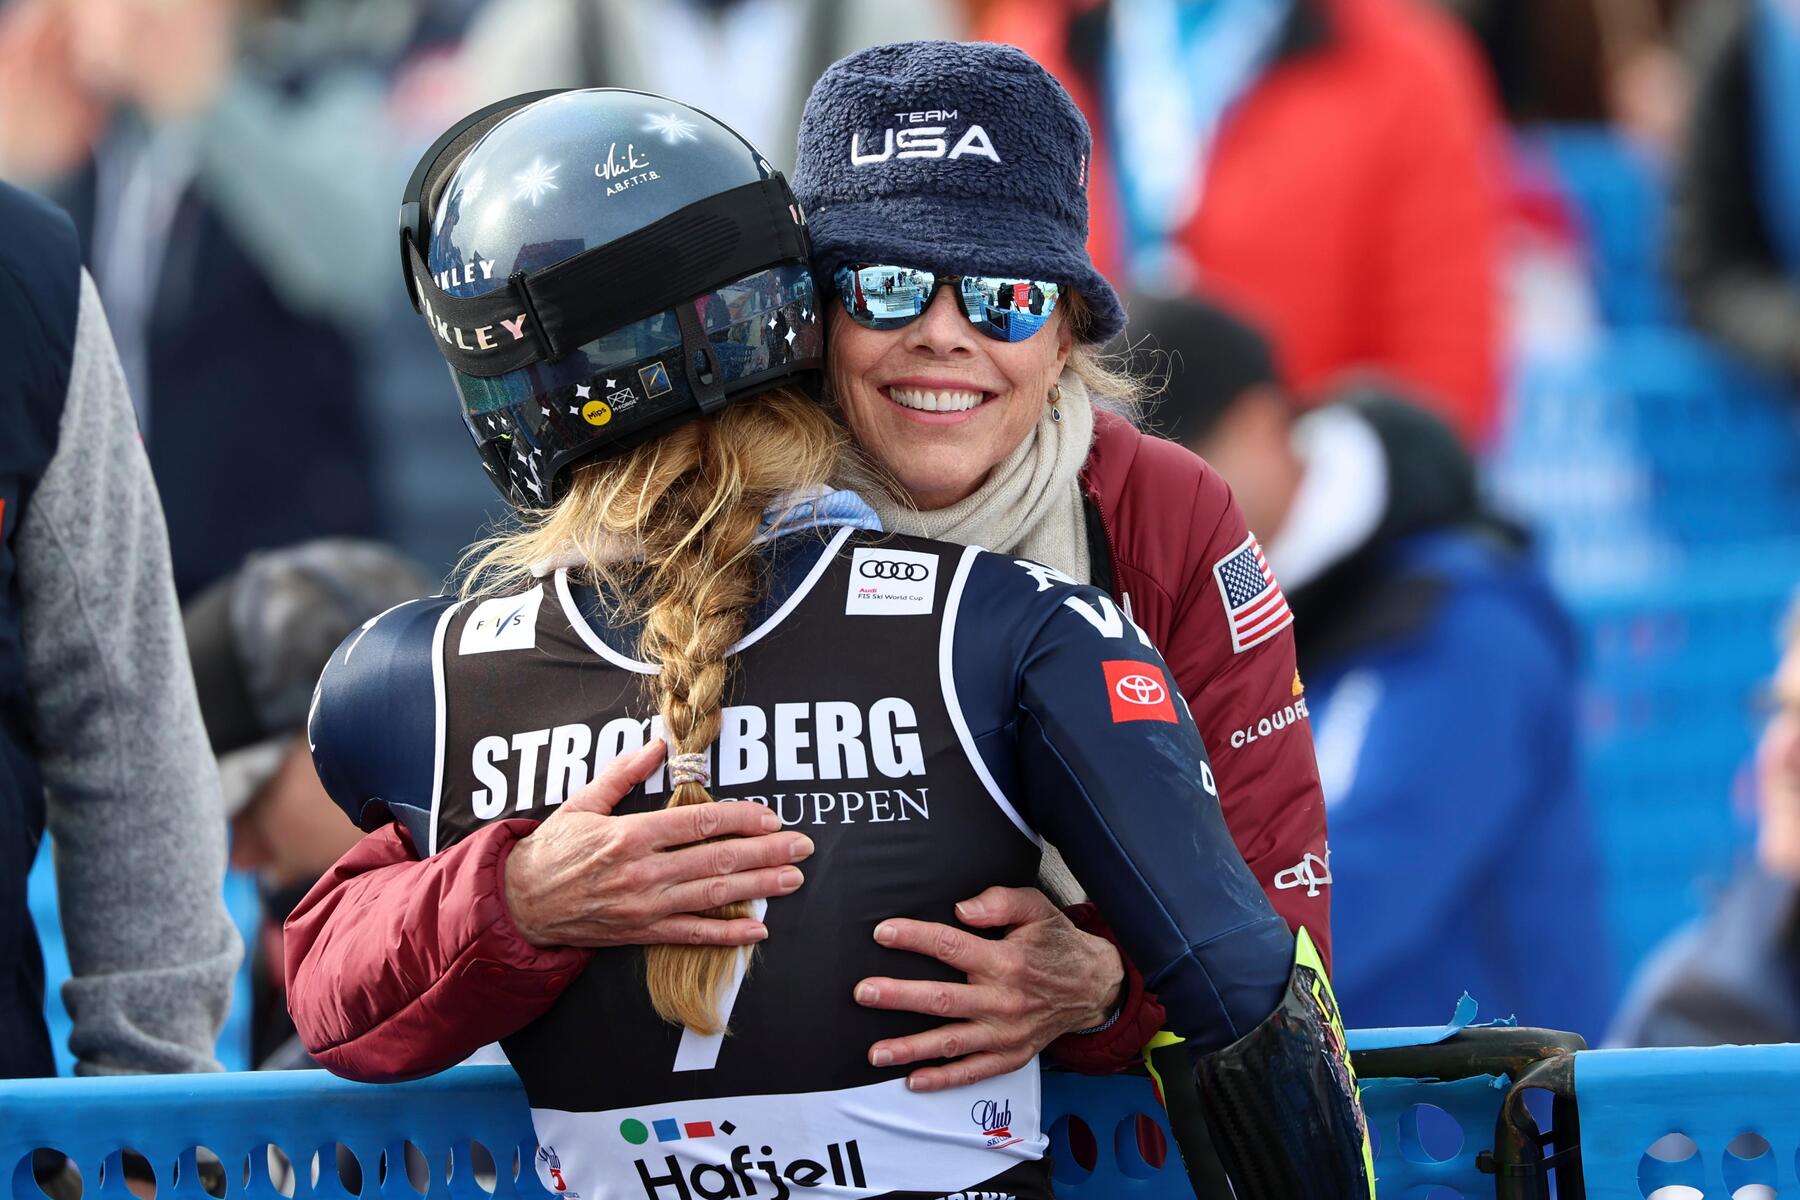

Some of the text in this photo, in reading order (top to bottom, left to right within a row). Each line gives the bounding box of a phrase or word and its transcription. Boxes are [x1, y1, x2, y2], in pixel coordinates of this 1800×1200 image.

[895, 109, 958, 123] TEAM
[850, 124, 1001, 167] USA
[587, 406, 607, 420] Mips
[718, 787, 930, 826] UPPEN
[971, 1098, 1012, 1131] Club
[633, 1138, 868, 1200] Hafjell
